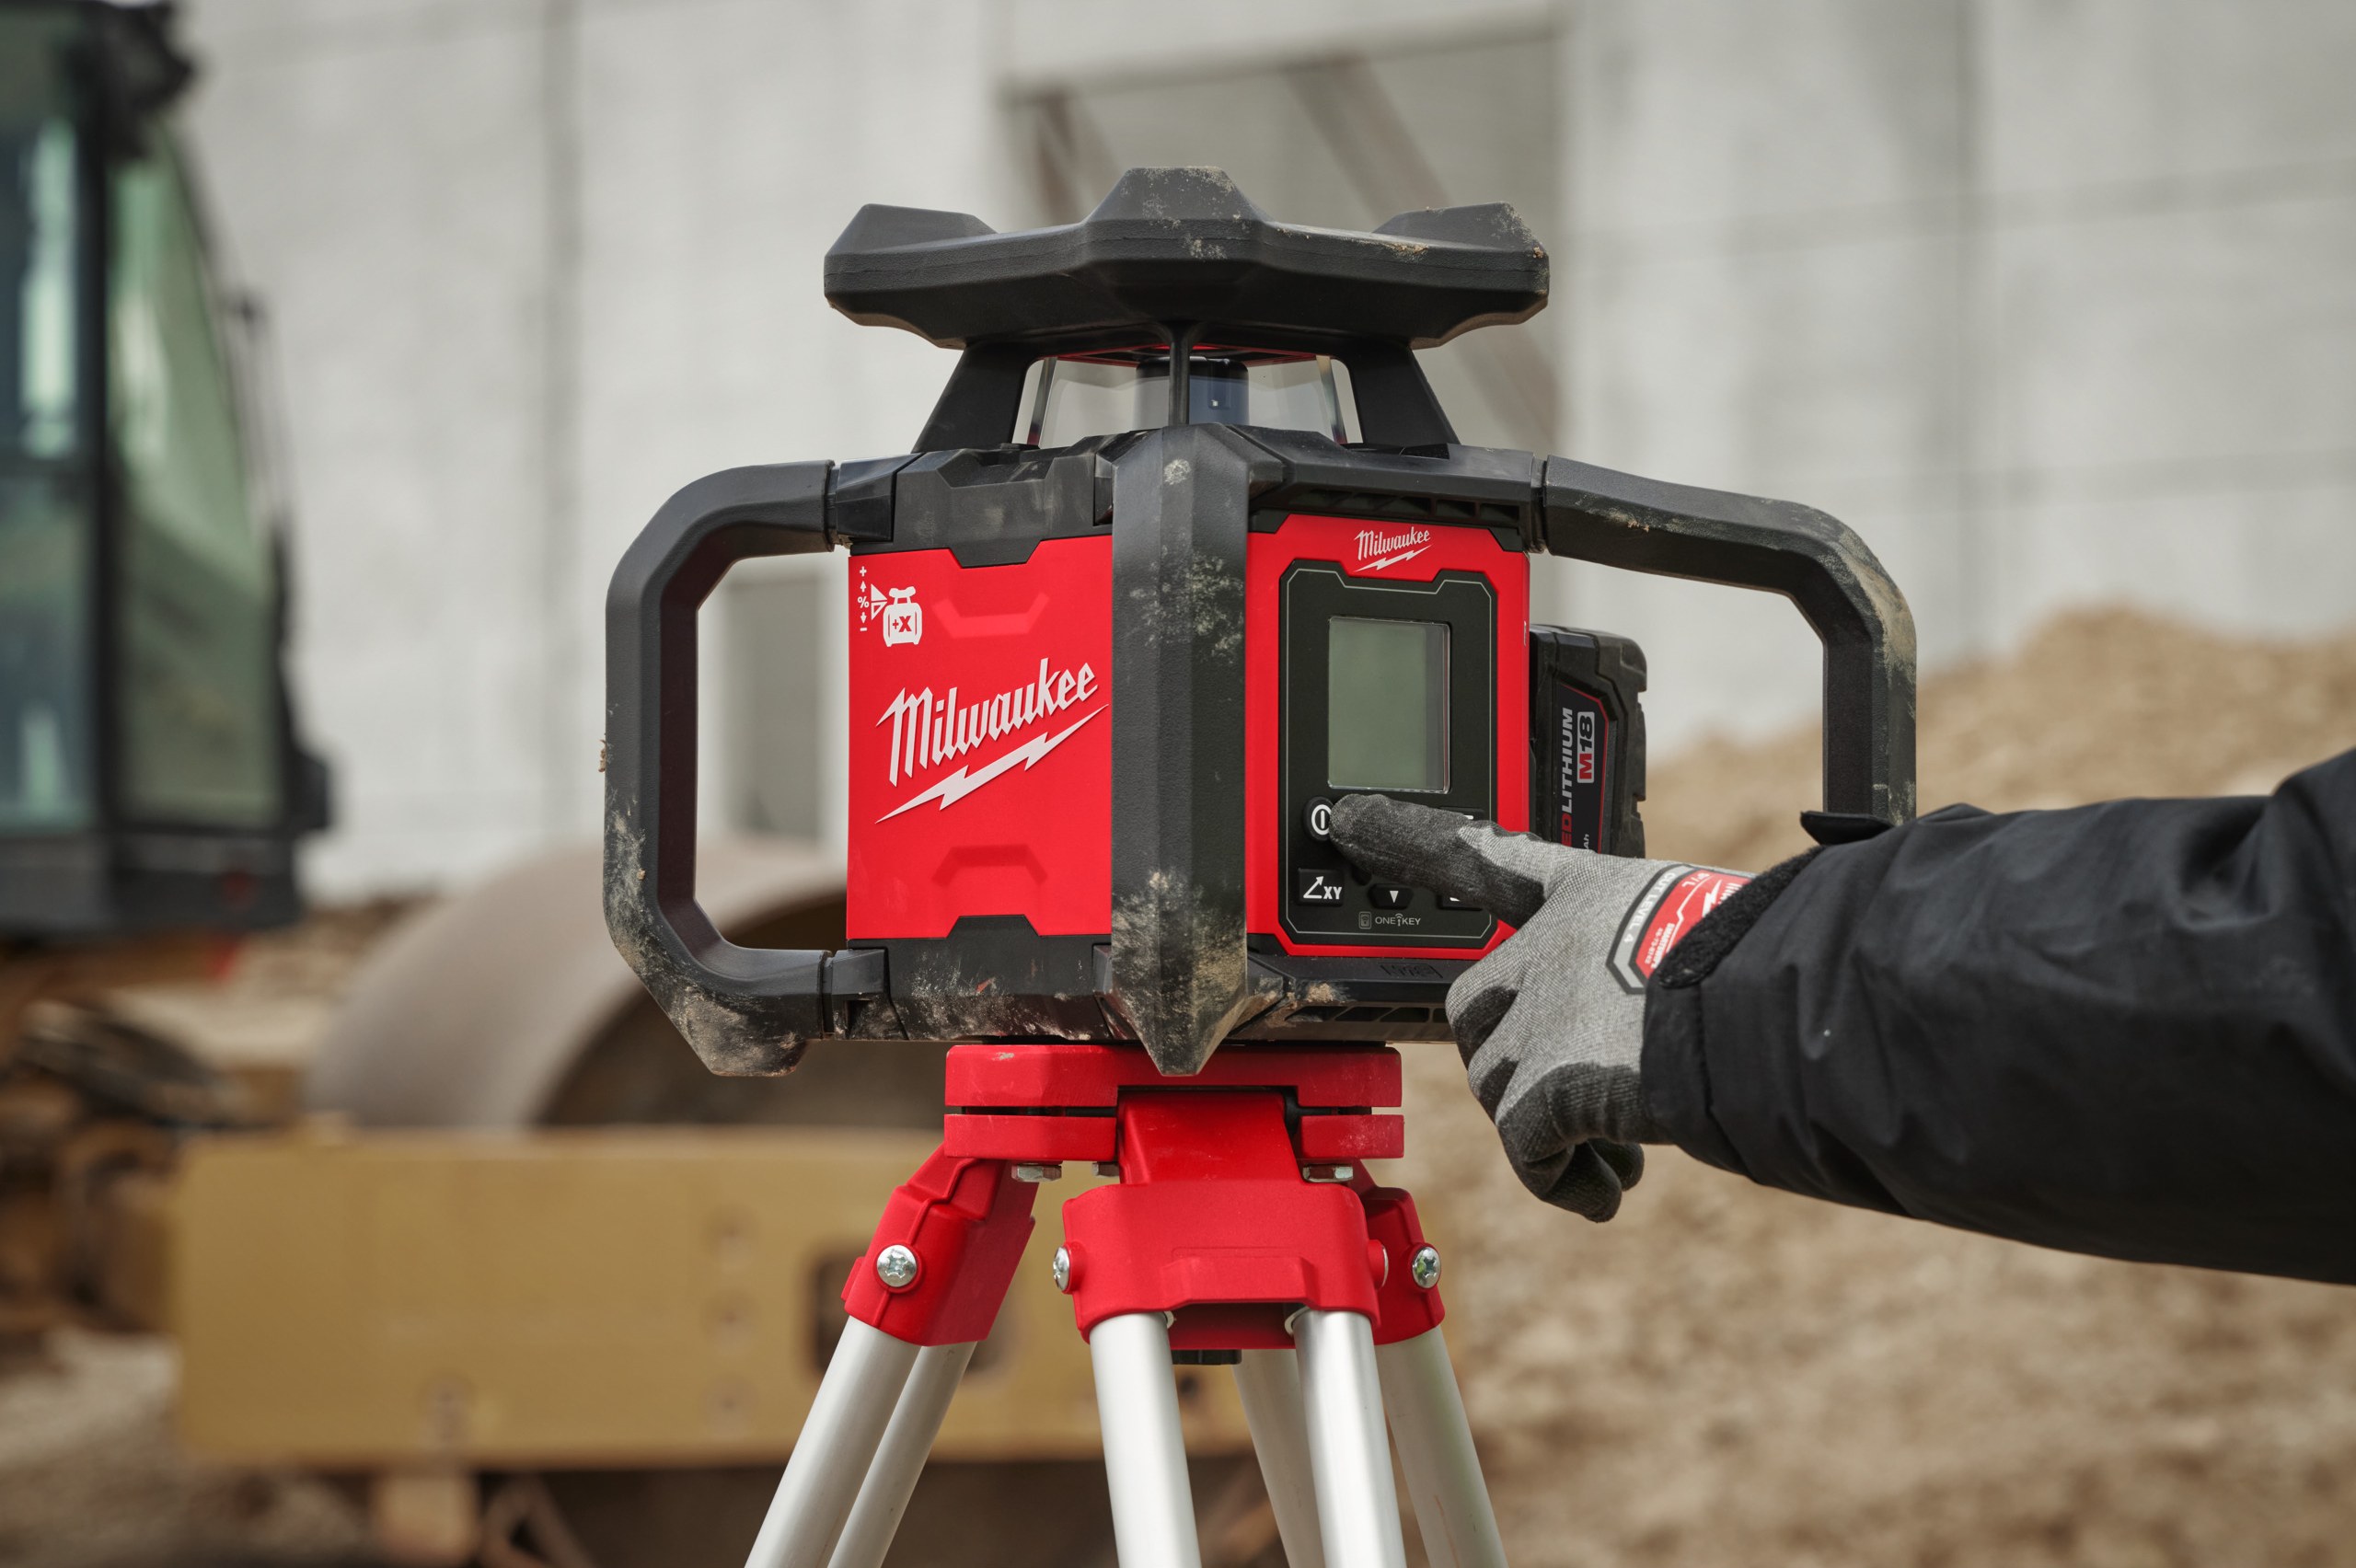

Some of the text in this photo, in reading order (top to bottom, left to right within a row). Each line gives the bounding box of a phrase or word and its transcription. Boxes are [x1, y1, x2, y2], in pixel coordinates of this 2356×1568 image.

[1354, 526, 1431, 560] Milwaukee
[875, 657, 1098, 787] Milwaukee
[1578, 715, 1593, 779] M18
[1561, 707, 1573, 847] EDLITHIUM
[1323, 886, 1342, 900] XY
[1623, 872, 1675, 943] CUT LEVEL 4
